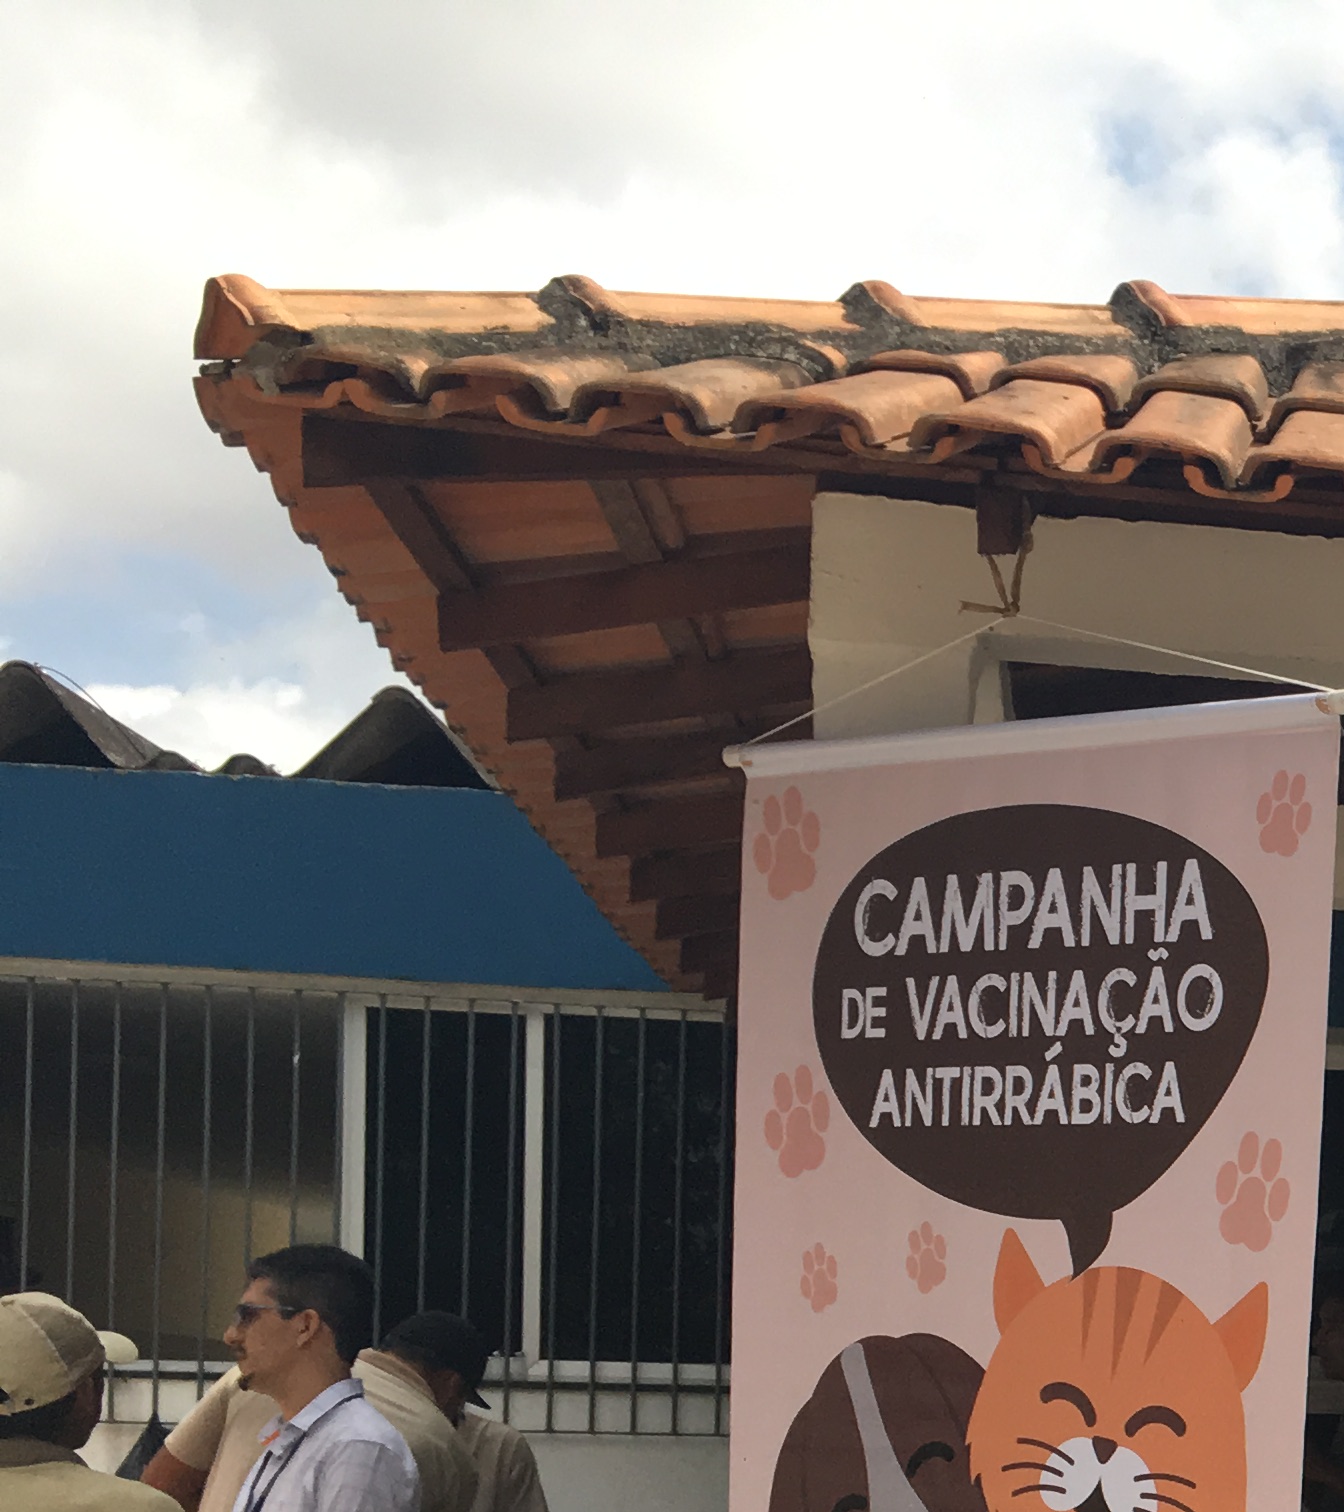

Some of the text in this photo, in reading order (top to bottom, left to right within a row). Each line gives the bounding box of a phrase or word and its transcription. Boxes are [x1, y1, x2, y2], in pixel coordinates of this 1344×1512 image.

[854, 858, 1213, 957] CAMPANHA
[841, 947, 1223, 1057] DE VACINAÇÃO
[869, 1042, 1186, 1128] ANTIRRÁBICA
